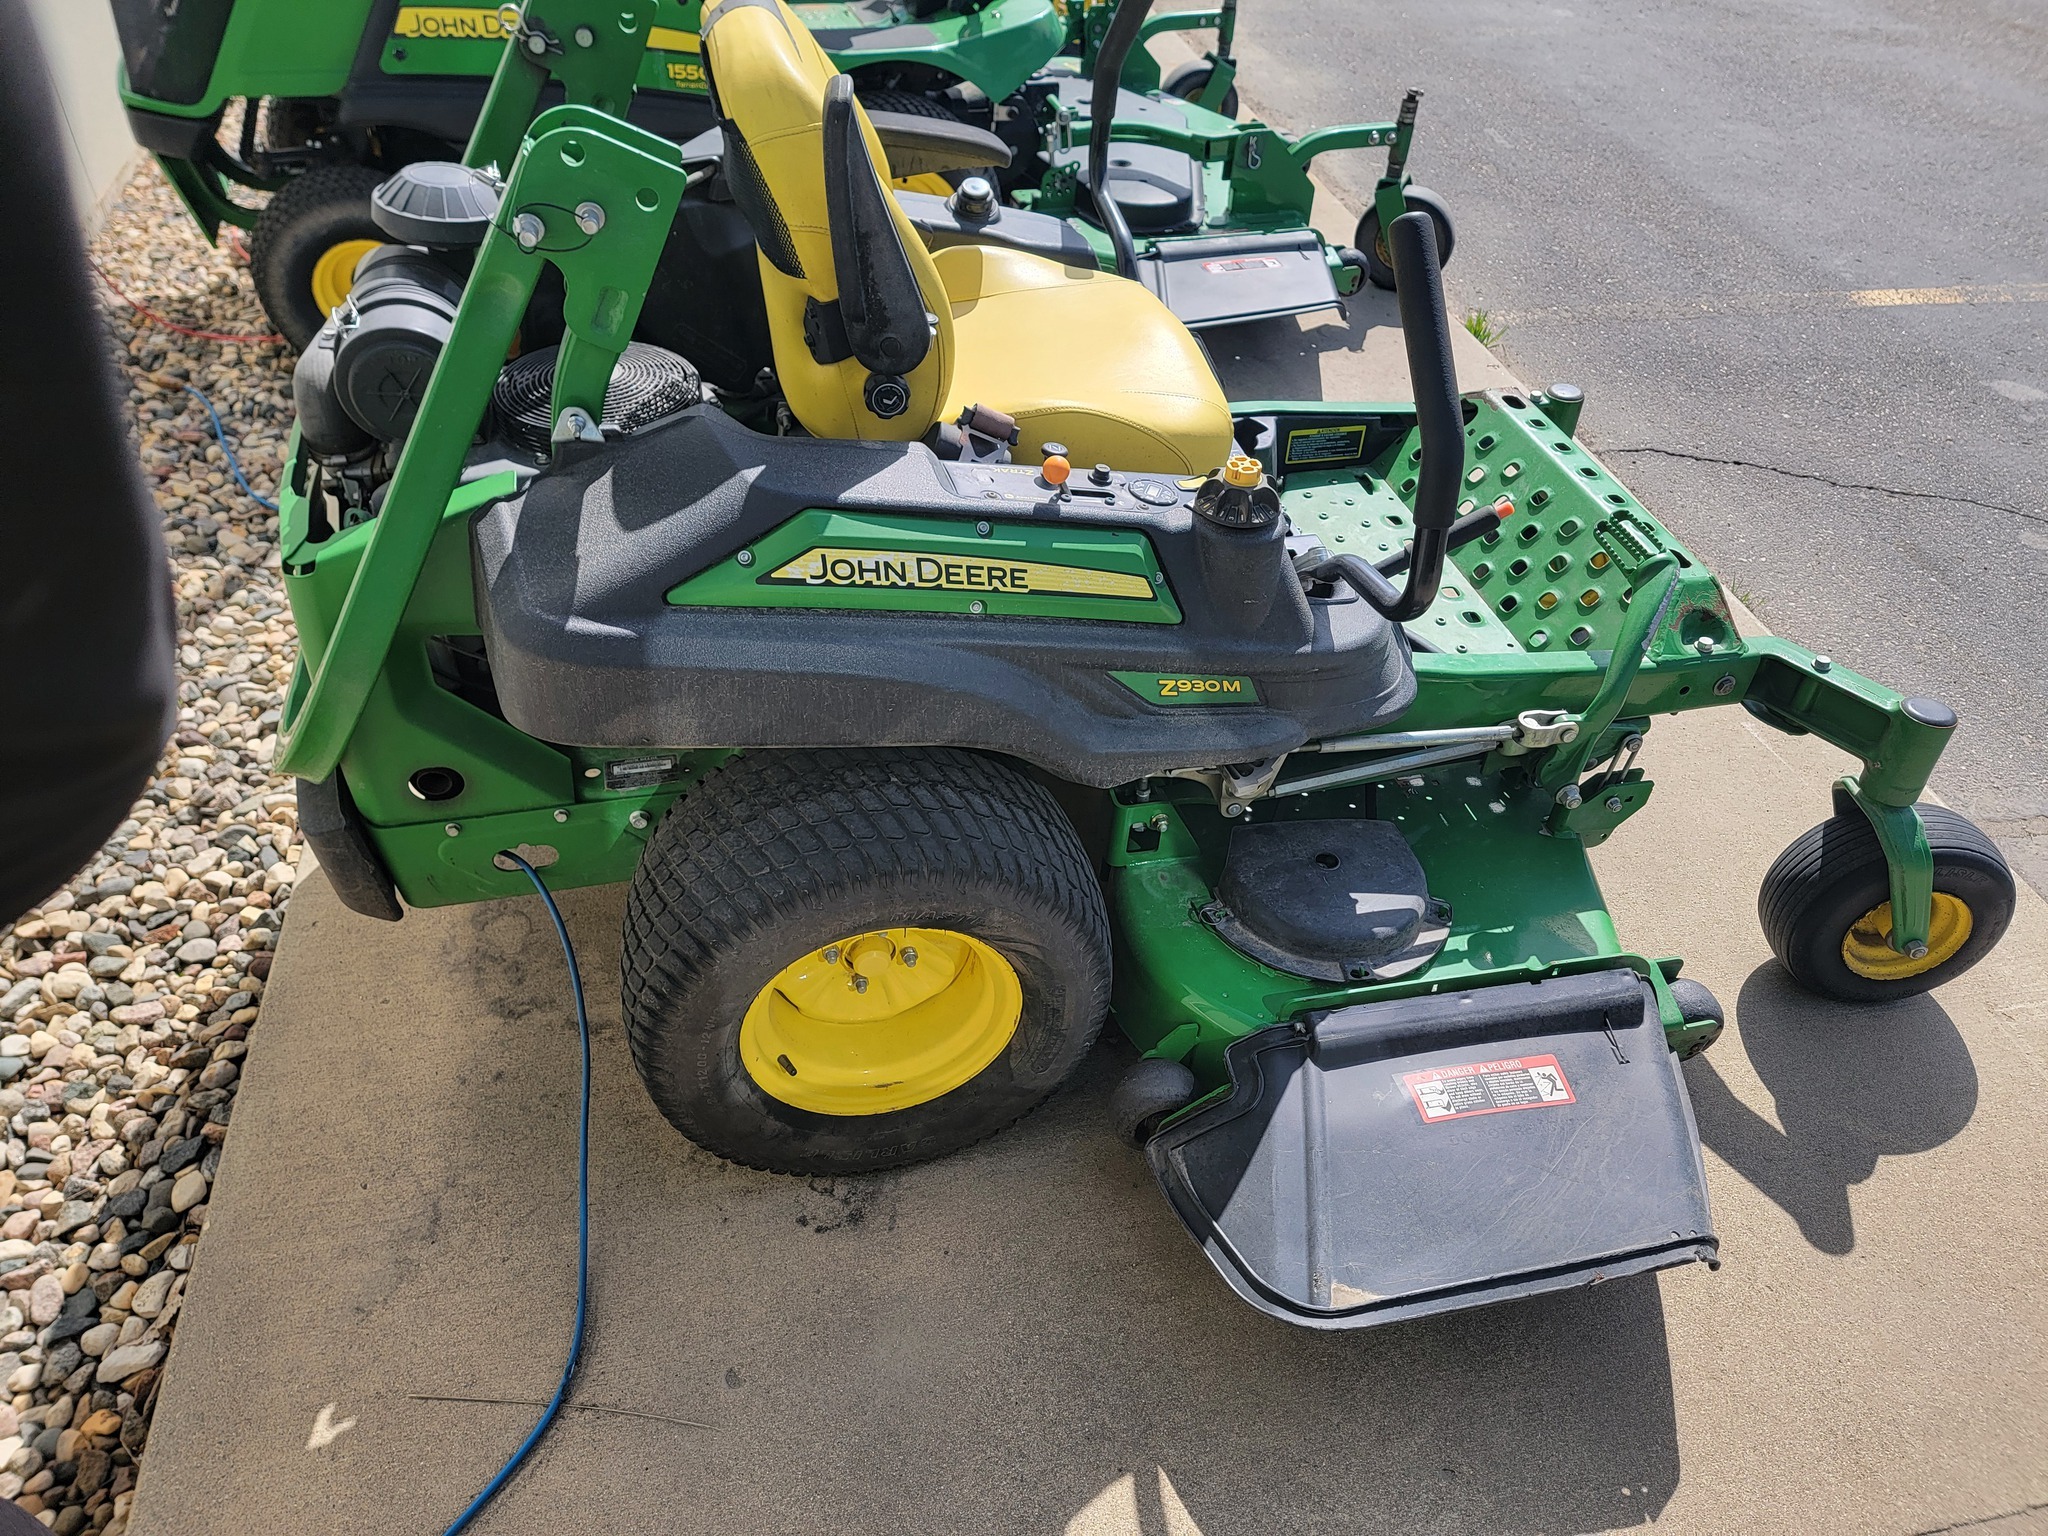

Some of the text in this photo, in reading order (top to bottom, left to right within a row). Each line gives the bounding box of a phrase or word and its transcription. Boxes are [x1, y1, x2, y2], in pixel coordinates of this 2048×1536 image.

[409, 13, 477, 34] JOHN
[809, 553, 1029, 589] JOHN DEERE
[1158, 679, 1241, 696] Z930M
[1441, 1060, 1522, 1079] DANGER PELIGRO
